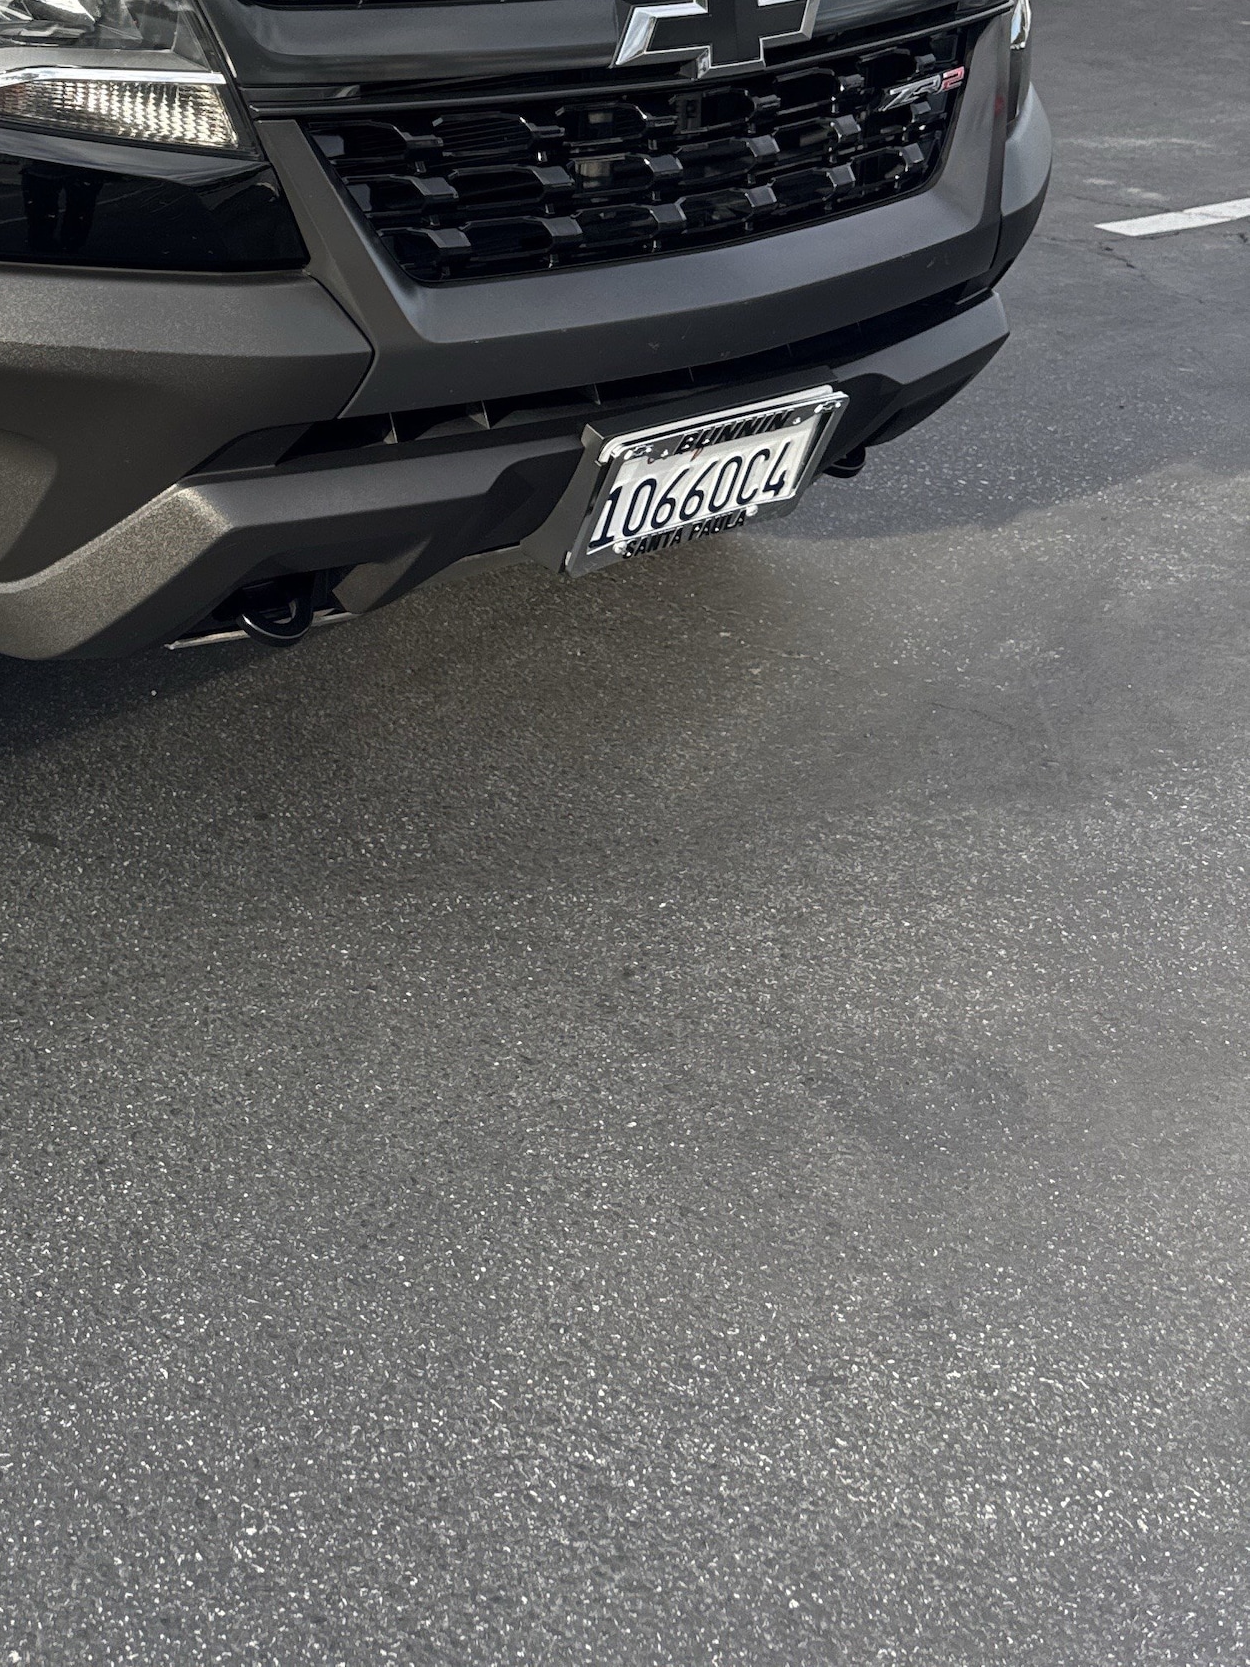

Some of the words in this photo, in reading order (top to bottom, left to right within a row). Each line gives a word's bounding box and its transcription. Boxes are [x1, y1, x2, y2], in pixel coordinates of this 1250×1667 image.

[880, 65, 965, 112] ZR2
[673, 408, 796, 455] BUNNIN
[588, 437, 792, 548] 10660C4
[623, 524, 684, 559] SANTA
[688, 509, 747, 541] PAULA
